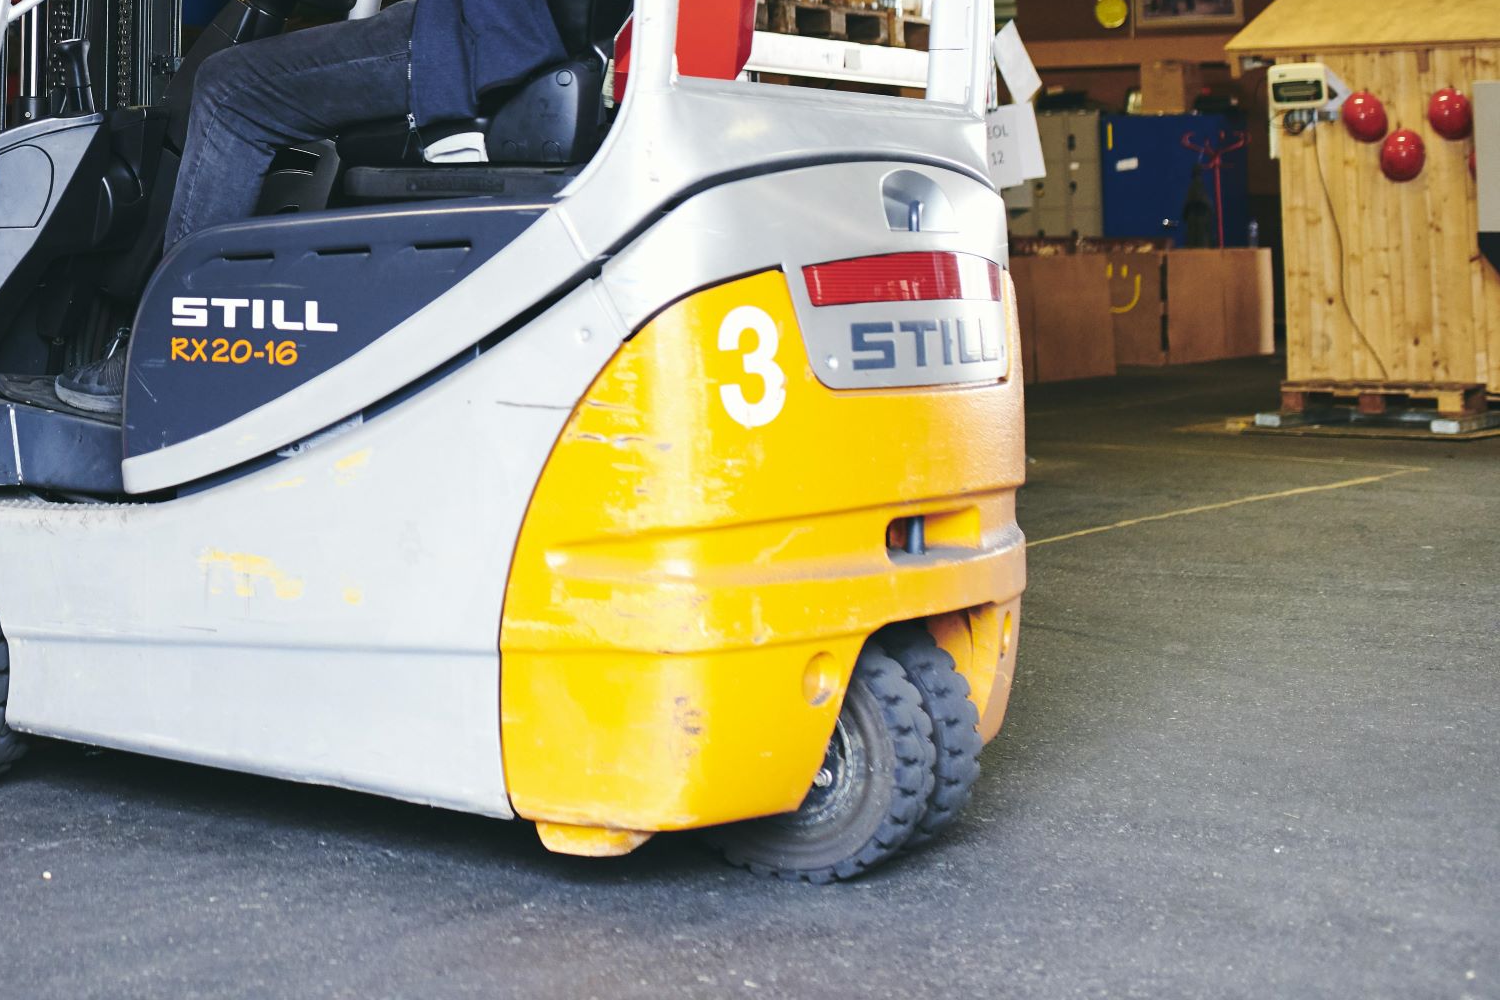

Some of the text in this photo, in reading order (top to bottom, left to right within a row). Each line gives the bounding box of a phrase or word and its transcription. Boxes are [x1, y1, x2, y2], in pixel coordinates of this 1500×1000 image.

[991, 152, 1004, 166] 12
[172, 297, 338, 332] STILL
[850, 317, 999, 371] STILL
[717, 305, 787, 429] 3
